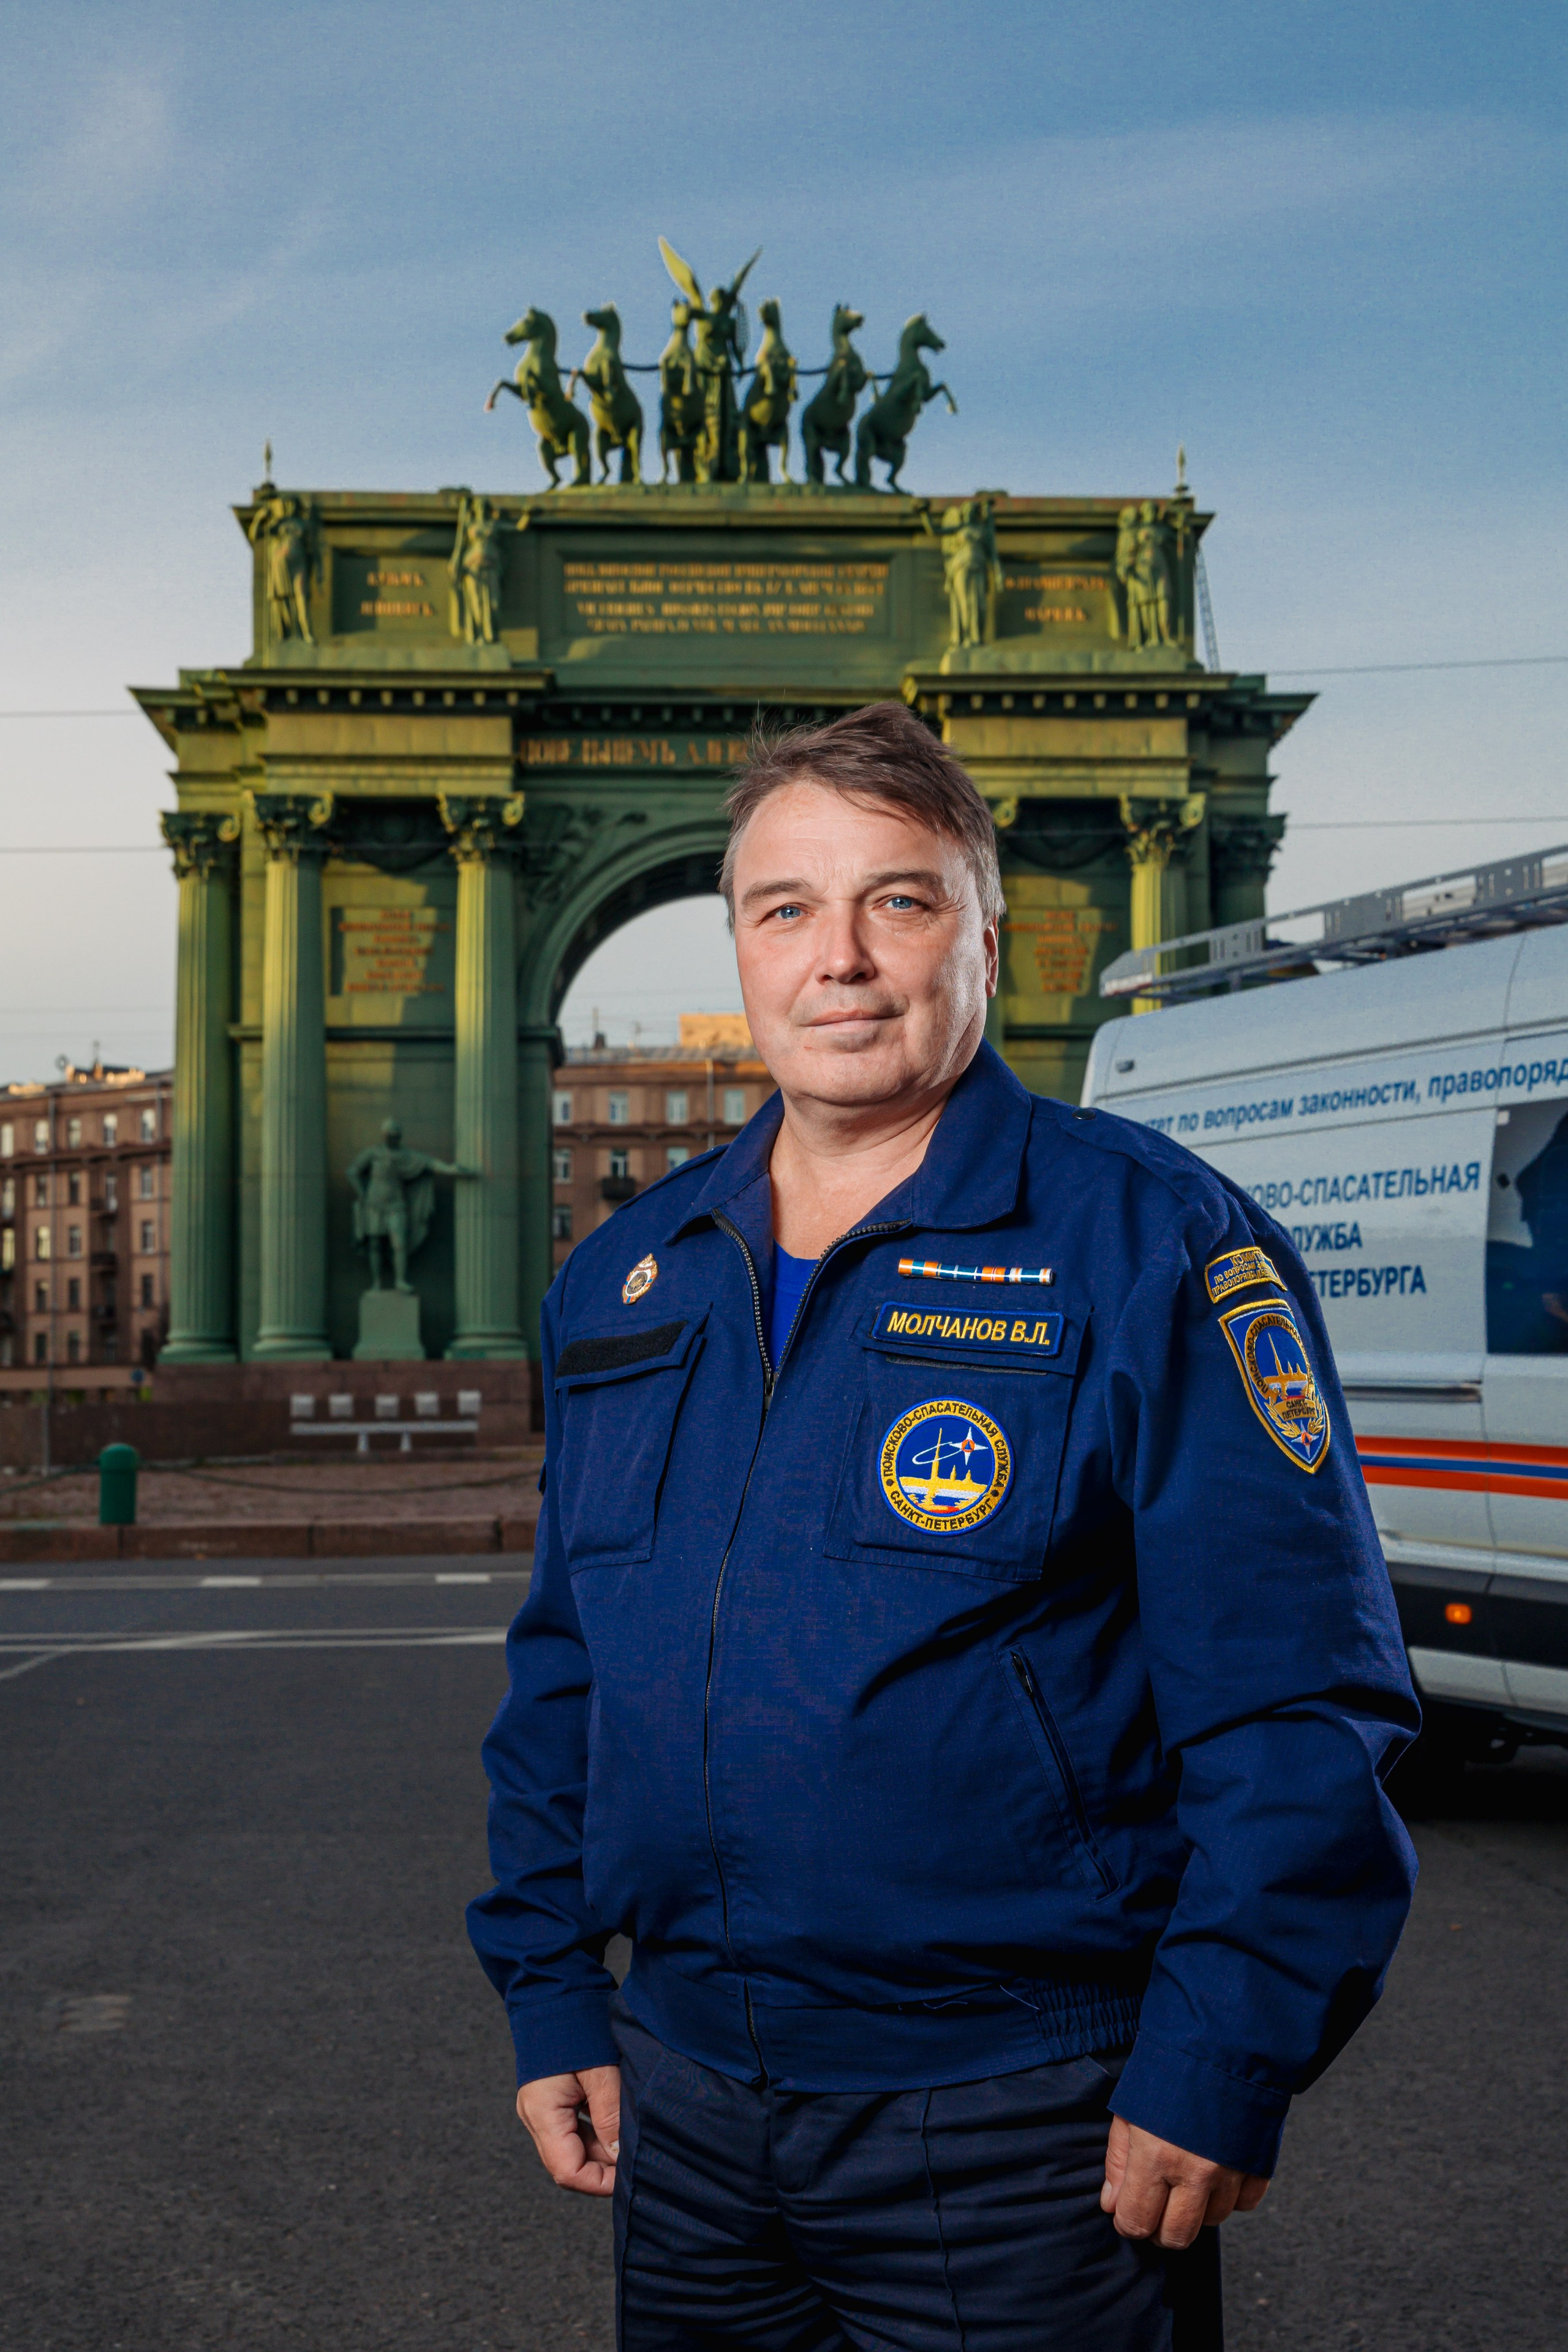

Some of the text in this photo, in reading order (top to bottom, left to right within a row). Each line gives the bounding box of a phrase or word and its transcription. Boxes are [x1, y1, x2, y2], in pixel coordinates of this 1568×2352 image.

[1177, 1112, 1199, 1133] по
[1203, 1098, 1294, 1133] вопросам
[1298, 1079, 1421, 1116] законности,
[1247, 1161, 1481, 1209] ОВО-СПАСАТЕЛЬНАЯ
[1292, 1221, 1363, 1252] ЛУЖБА
[1214, 1274, 1224, 1284] ПО
[1224, 1262, 1256, 1280] ВОПРОСАМ
[887, 1311, 1049, 1345] МОЛЧАНОВ В.Л.
[881, 1402, 1008, 1488] ПОИСКОВО-СПАСАТЕЛЬНАЯ СЛУЖБА
[891, 1490, 992, 1530] САНКТ-ПЕТЕРБУРГ
